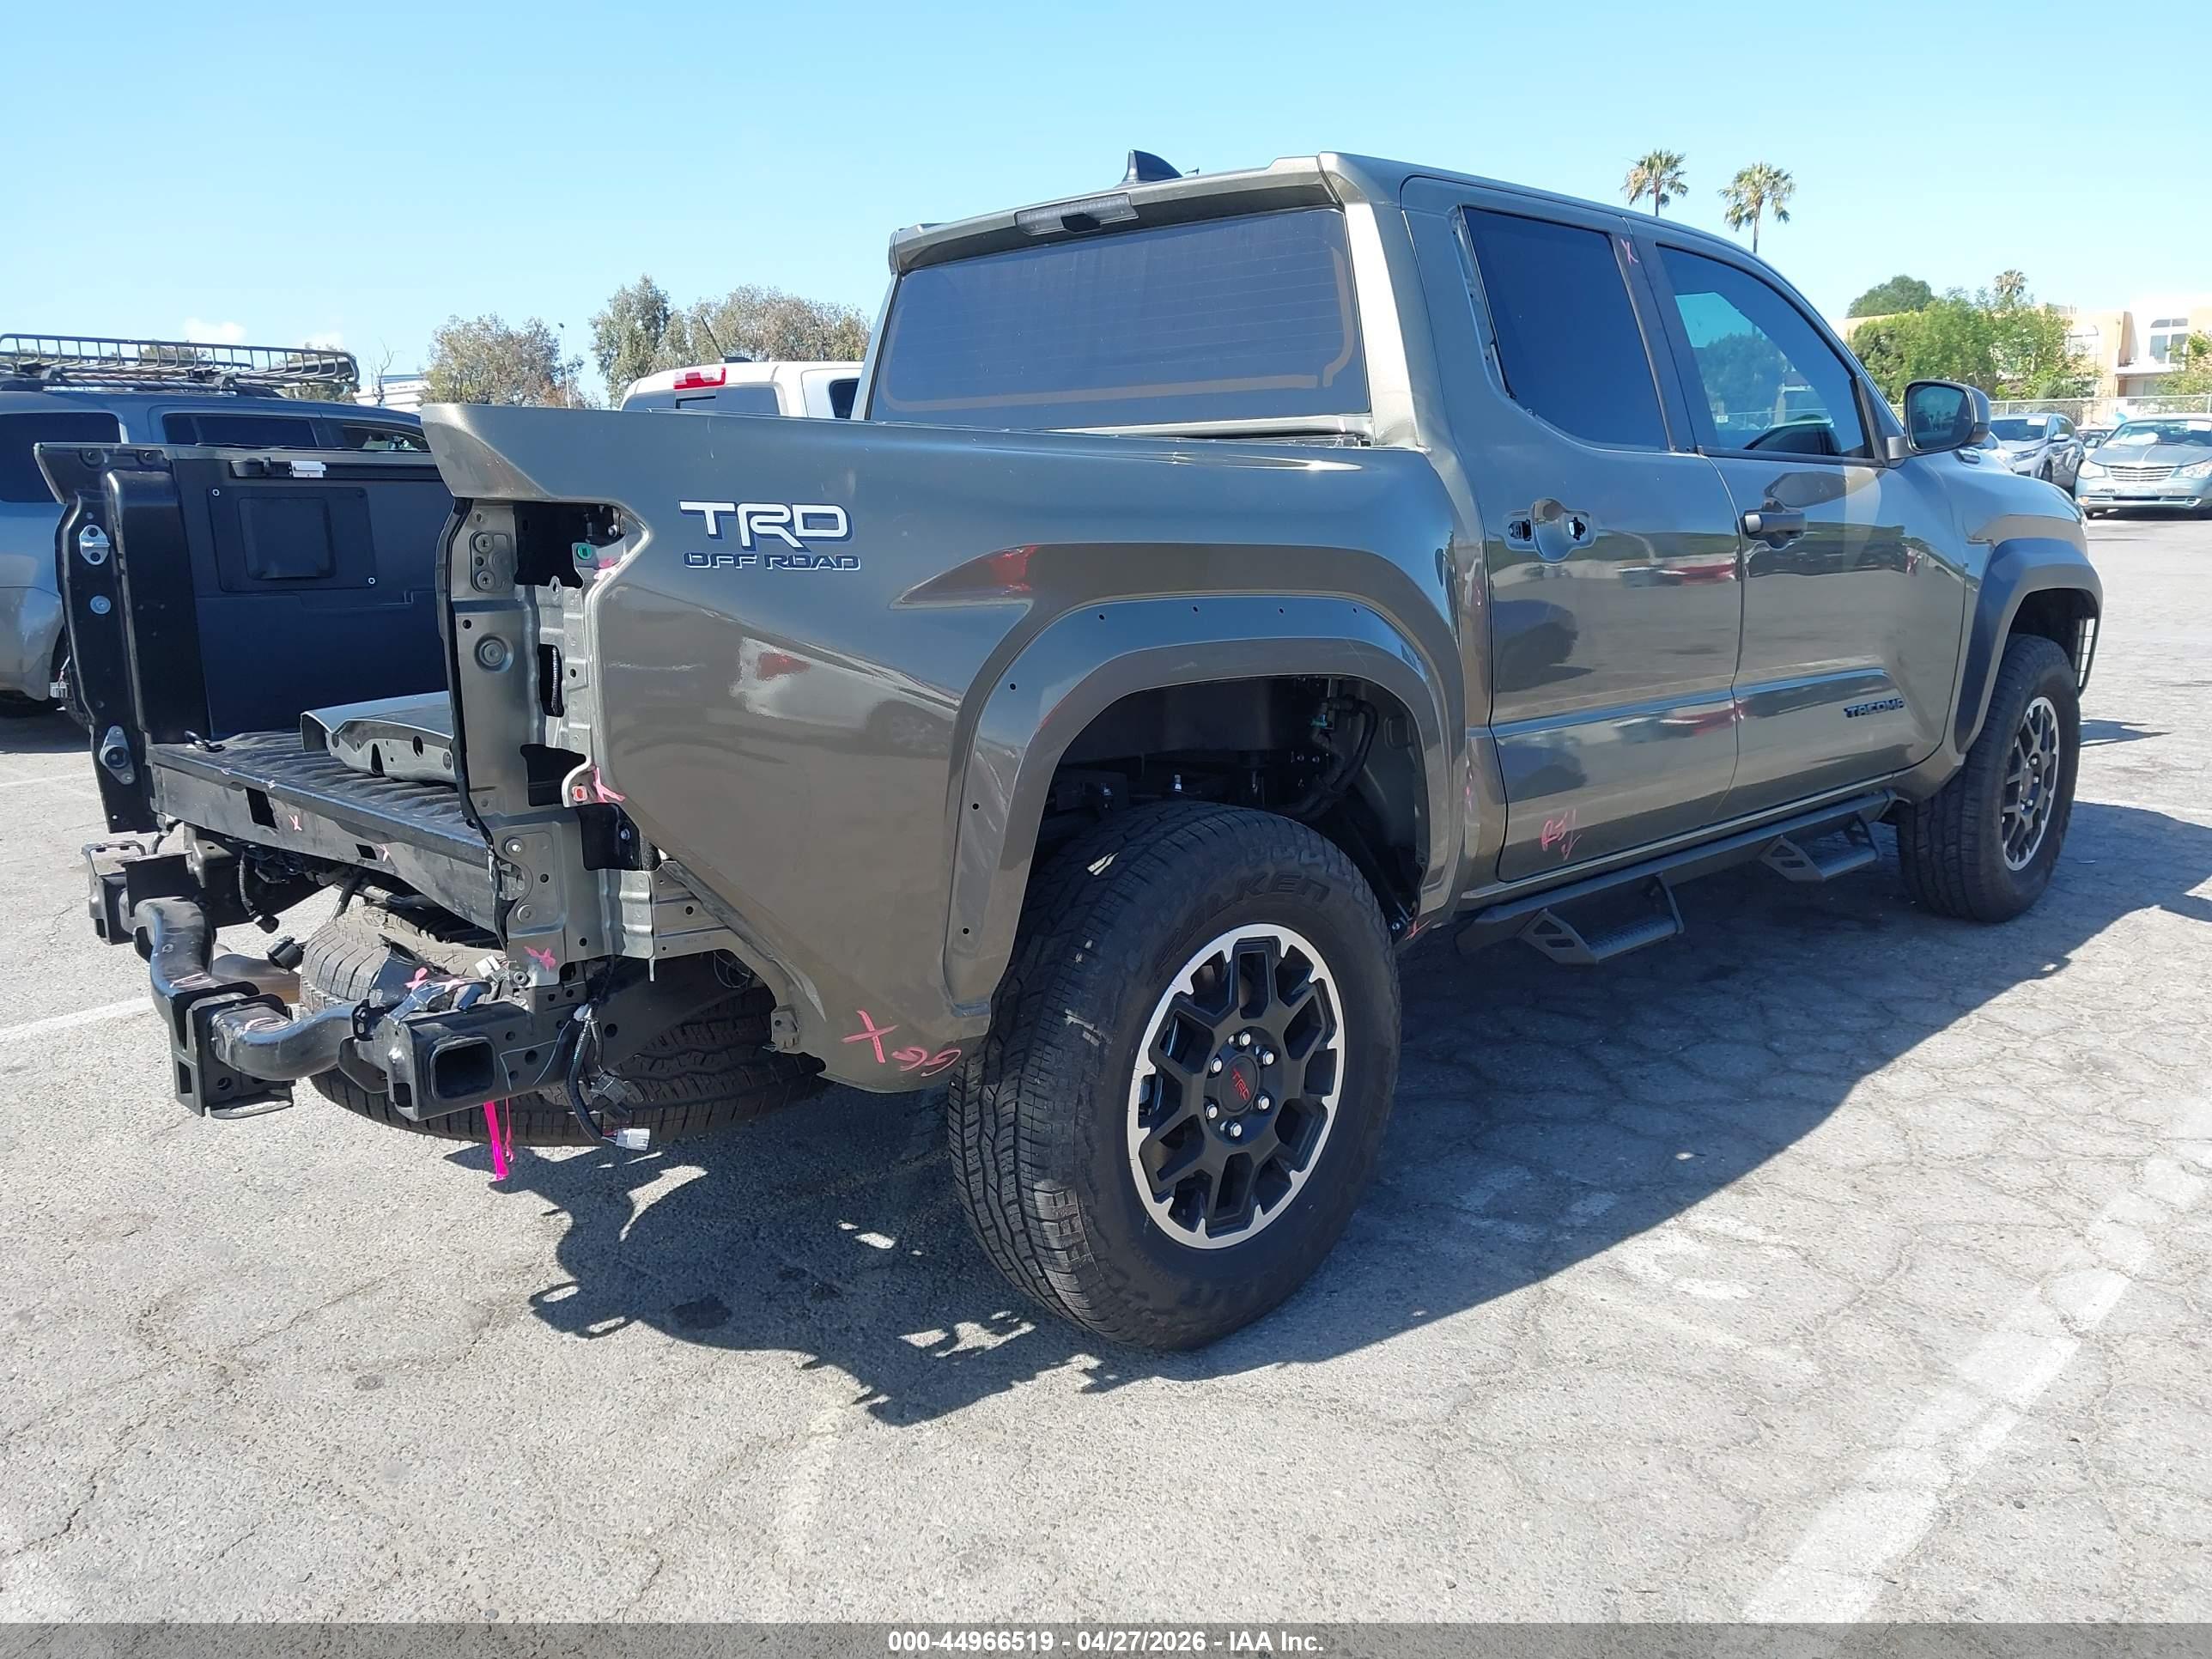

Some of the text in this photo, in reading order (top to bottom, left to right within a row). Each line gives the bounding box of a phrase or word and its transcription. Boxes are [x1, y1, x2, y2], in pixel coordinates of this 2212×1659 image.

[679, 501, 853, 552] TRD
[684, 552, 861, 571] OFF ROAD
[1844, 697, 1905, 718] TACOMA
[1232, 1067, 1250, 1100] TRD
